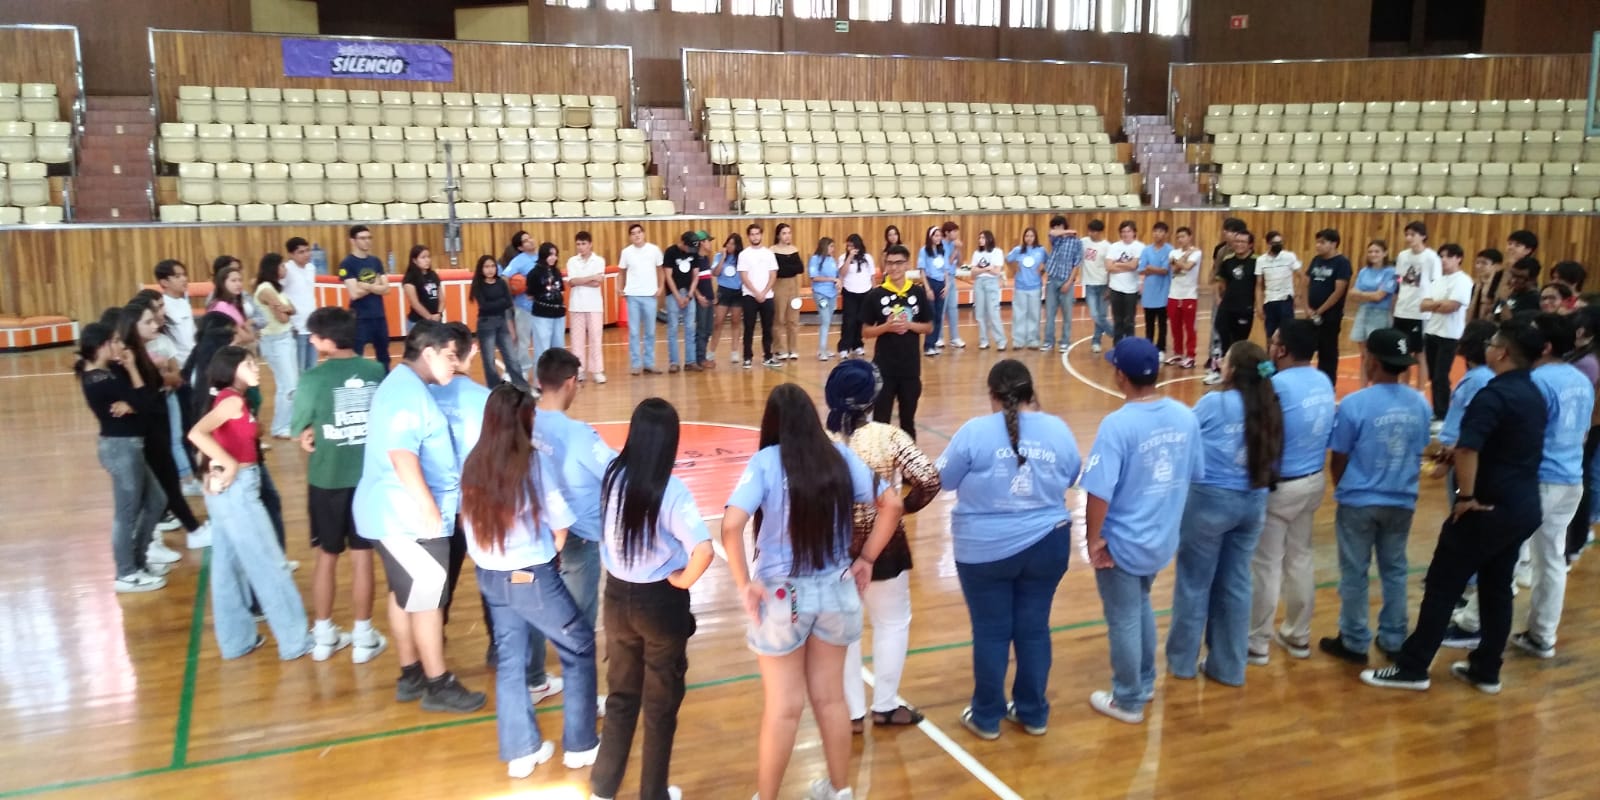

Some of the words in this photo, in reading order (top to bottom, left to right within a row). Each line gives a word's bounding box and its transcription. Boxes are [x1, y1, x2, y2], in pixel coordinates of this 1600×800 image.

[331, 56, 404, 74] SILENCIO
[995, 447, 1027, 459] GOD
[1028, 447, 1056, 464] NEWS
